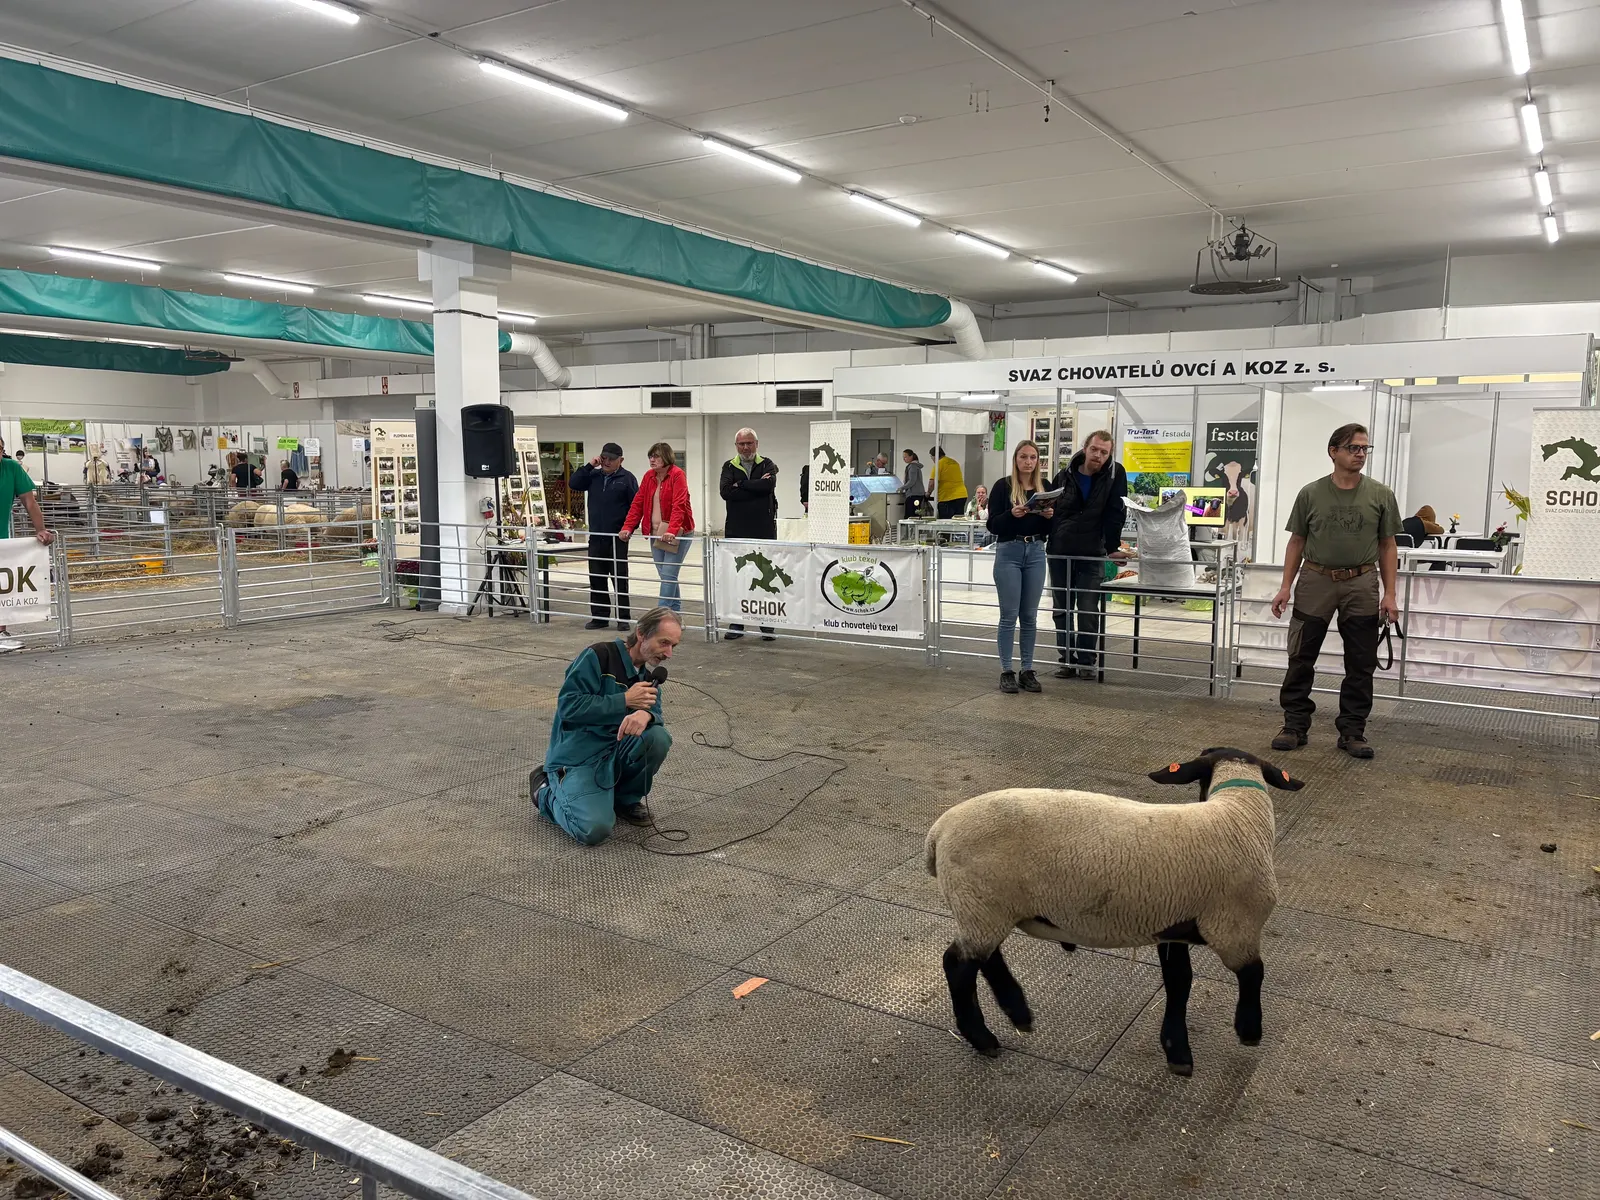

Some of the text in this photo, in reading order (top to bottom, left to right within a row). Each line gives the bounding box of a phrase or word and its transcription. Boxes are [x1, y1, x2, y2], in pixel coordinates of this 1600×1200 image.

[1008, 359, 1335, 382] SVAZ CHOVATELŮ OVCÍ A KOZ z. s.
[1162, 430, 1191, 438] festada
[815, 480, 842, 492] SCHOK
[1545, 490, 1600, 506] SCHO
[841, 555, 878, 565] klub texel
[0, 597, 39, 607] VCÍ A KOZ
[741, 599, 787, 617] SCHOK
[842, 605, 876, 614] www.schok.cz
[823, 619, 898, 632] klub chovatelů texel
